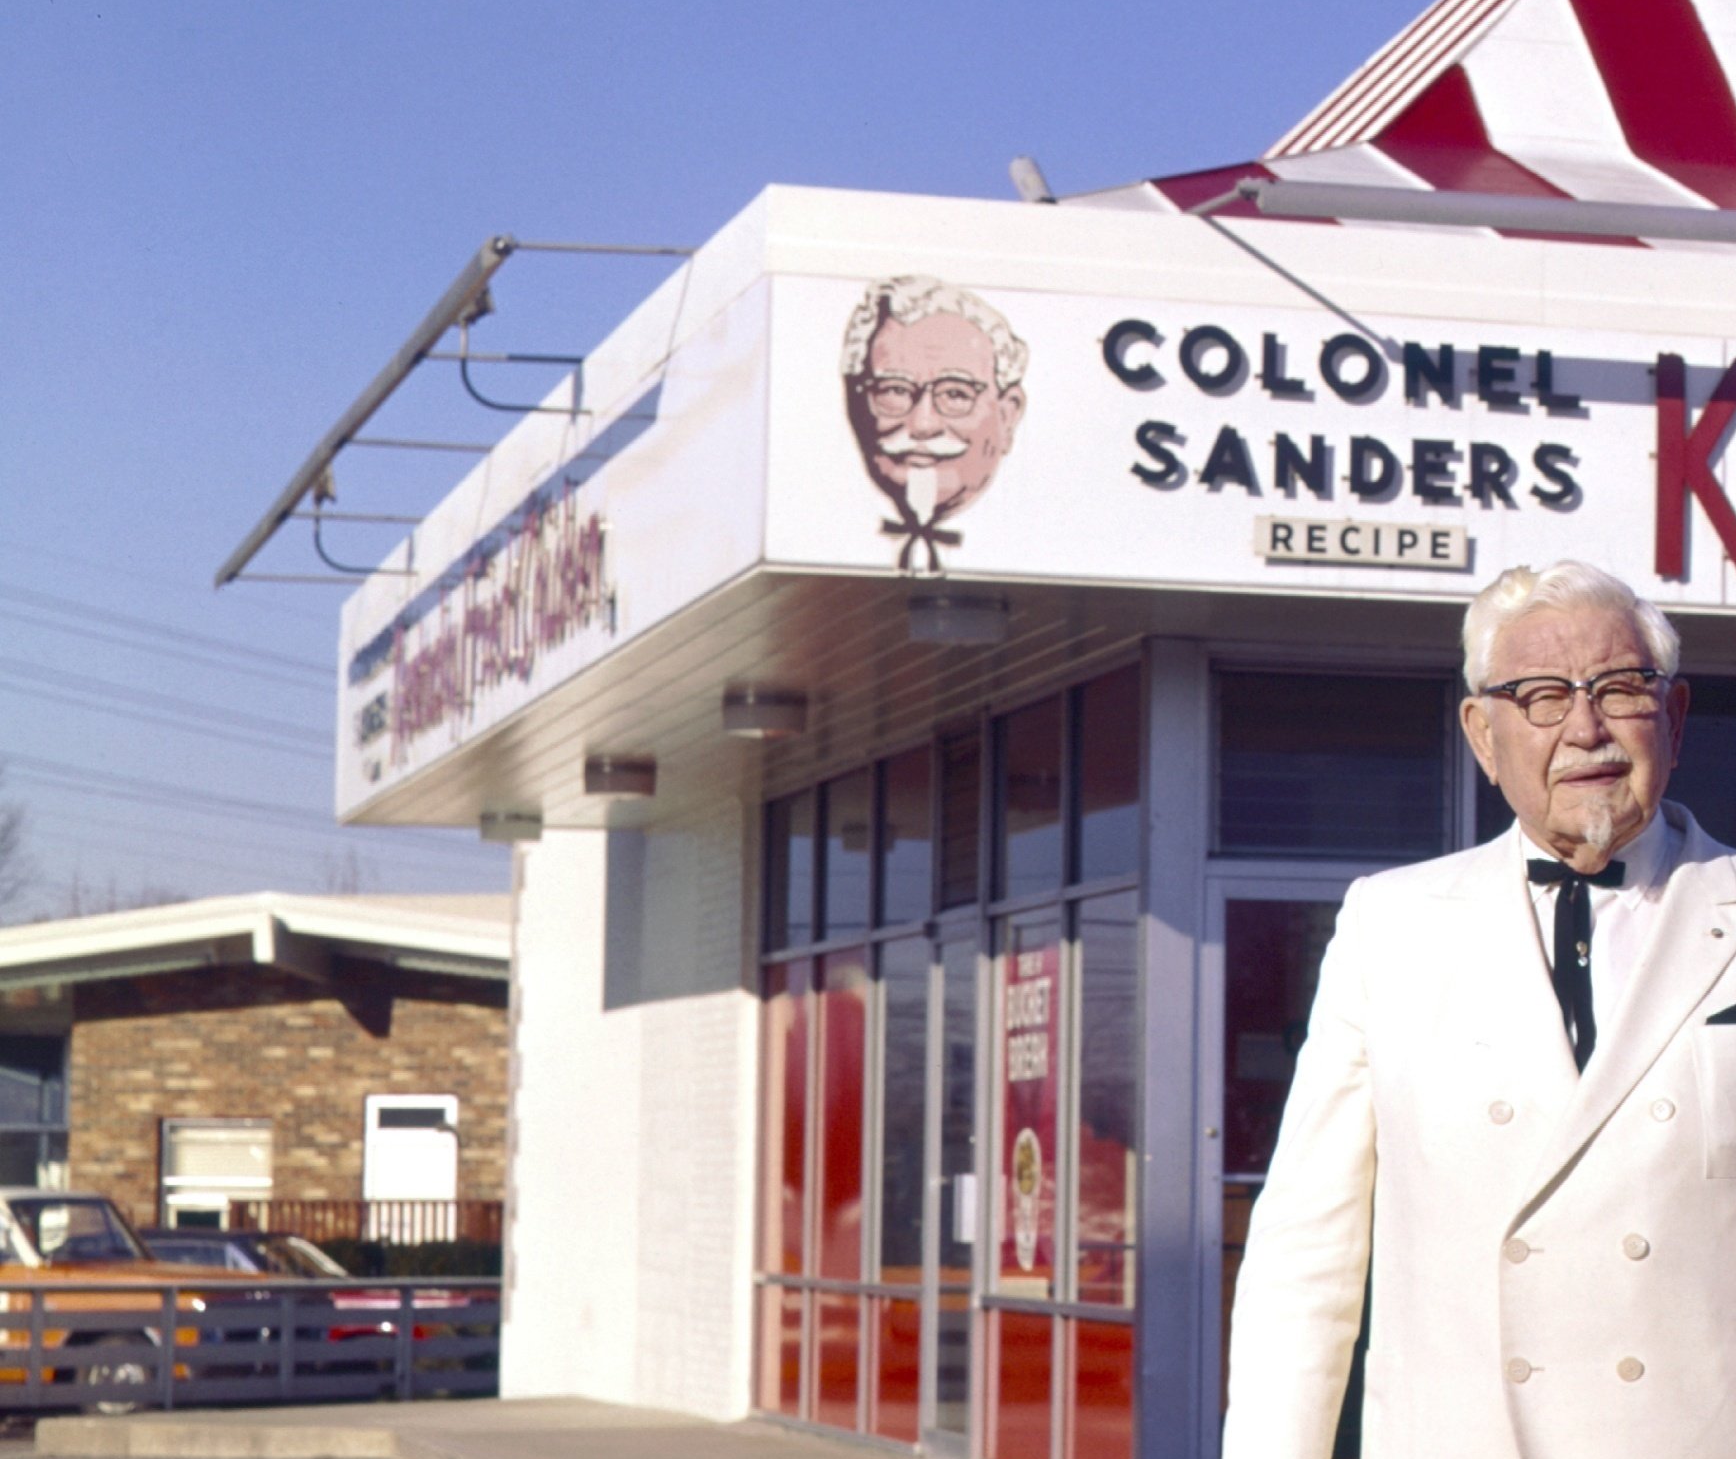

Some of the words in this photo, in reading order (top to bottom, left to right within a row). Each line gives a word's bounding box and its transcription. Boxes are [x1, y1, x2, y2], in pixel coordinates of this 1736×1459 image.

[1102, 319, 1581, 408] COLONEL
[1132, 420, 1578, 504] SANDERS
[1270, 522, 1451, 560] RECIPE
